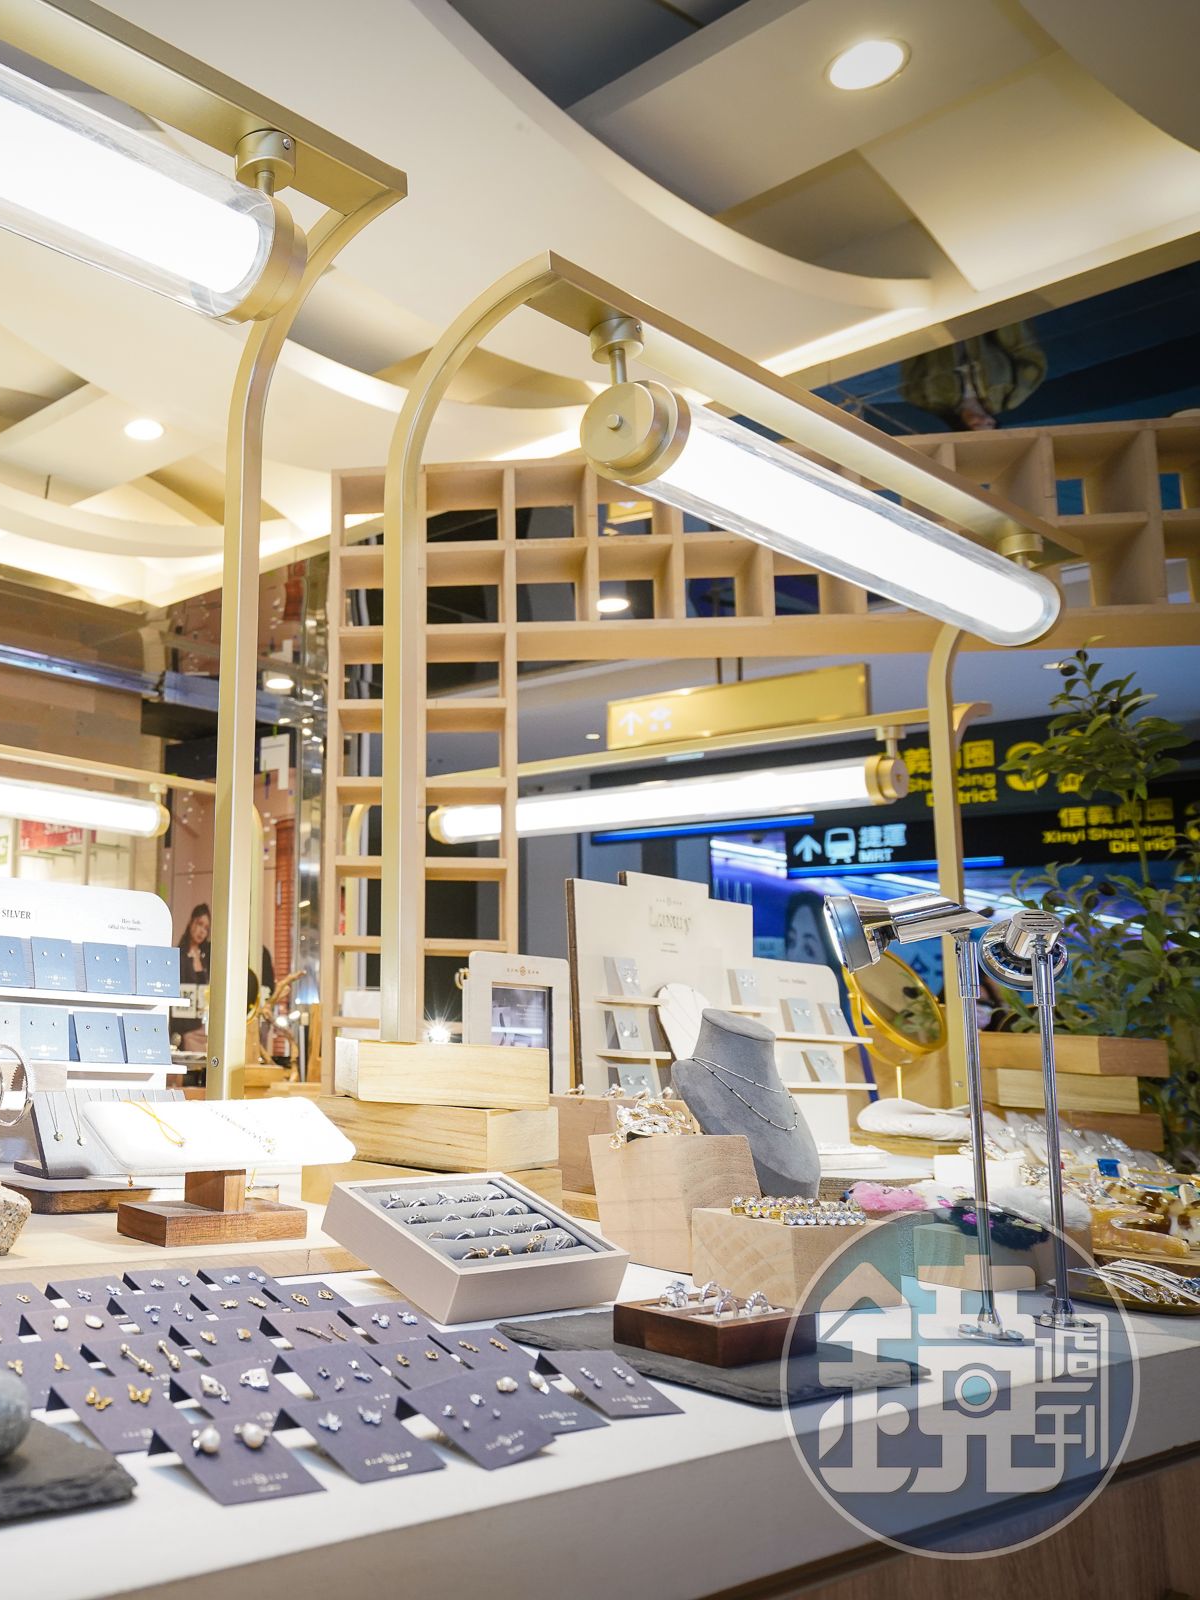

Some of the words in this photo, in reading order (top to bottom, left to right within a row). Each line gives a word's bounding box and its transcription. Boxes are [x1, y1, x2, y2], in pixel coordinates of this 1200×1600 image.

[858, 823, 907, 849] 捷運
[1042, 829, 1086, 845] Xinyi
[858, 848, 894, 863] MRT
[1, 909, 31, 919] SILVER
